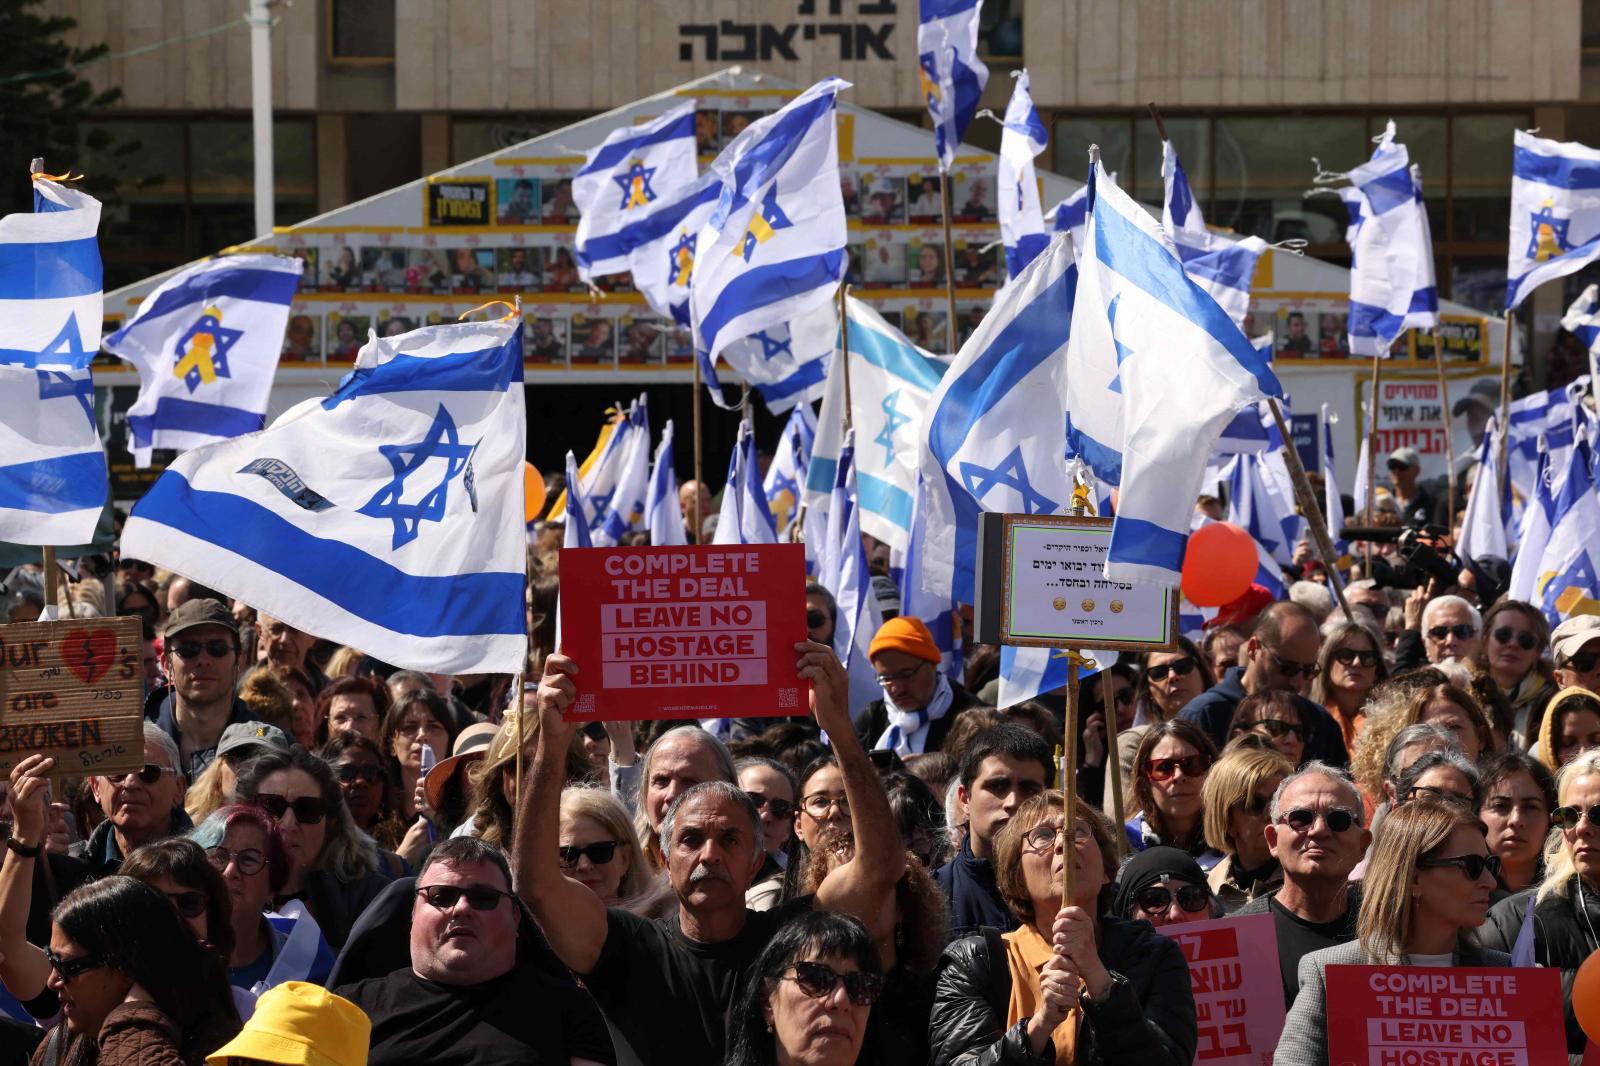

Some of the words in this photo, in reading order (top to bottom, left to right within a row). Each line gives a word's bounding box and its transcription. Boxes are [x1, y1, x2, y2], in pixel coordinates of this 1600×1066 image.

[679, 19, 896, 61] אריאלה
[1385, 384, 1438, 400] מחזירים
[1383, 405, 1414, 421] איתי
[1419, 405, 1441, 421] את
[1376, 428, 1448, 454] הביתה
[1073, 545, 1092, 553] וכפיר
[604, 552, 760, 576] COMPLETE
[1033, 560, 1057, 570] ימים
[1060, 561, 1087, 571] יבואו
[611, 578, 671, 599] THE
[679, 576, 749, 598] DEAL
[1094, 580, 1132, 591] בסליחה
[615, 606, 701, 629] LEAVE
[710, 604, 753, 626] NO
[614, 634, 755, 658] HOSTAGE
[629, 662, 741, 685] BEHIND
[12, 692, 59, 711] are
[1191, 963, 1243, 994] עוצ
[1368, 972, 1517, 995] COMPLETE
[1216, 998, 1248, 1019] עד
[1375, 995, 1433, 1016] THE
[1440, 998, 1508, 1017] DEAL
[1381, 1022, 1463, 1043] LEAVE
[1471, 1024, 1513, 1044] NO
[1381, 1050, 1516, 1066] HOSTAGE
